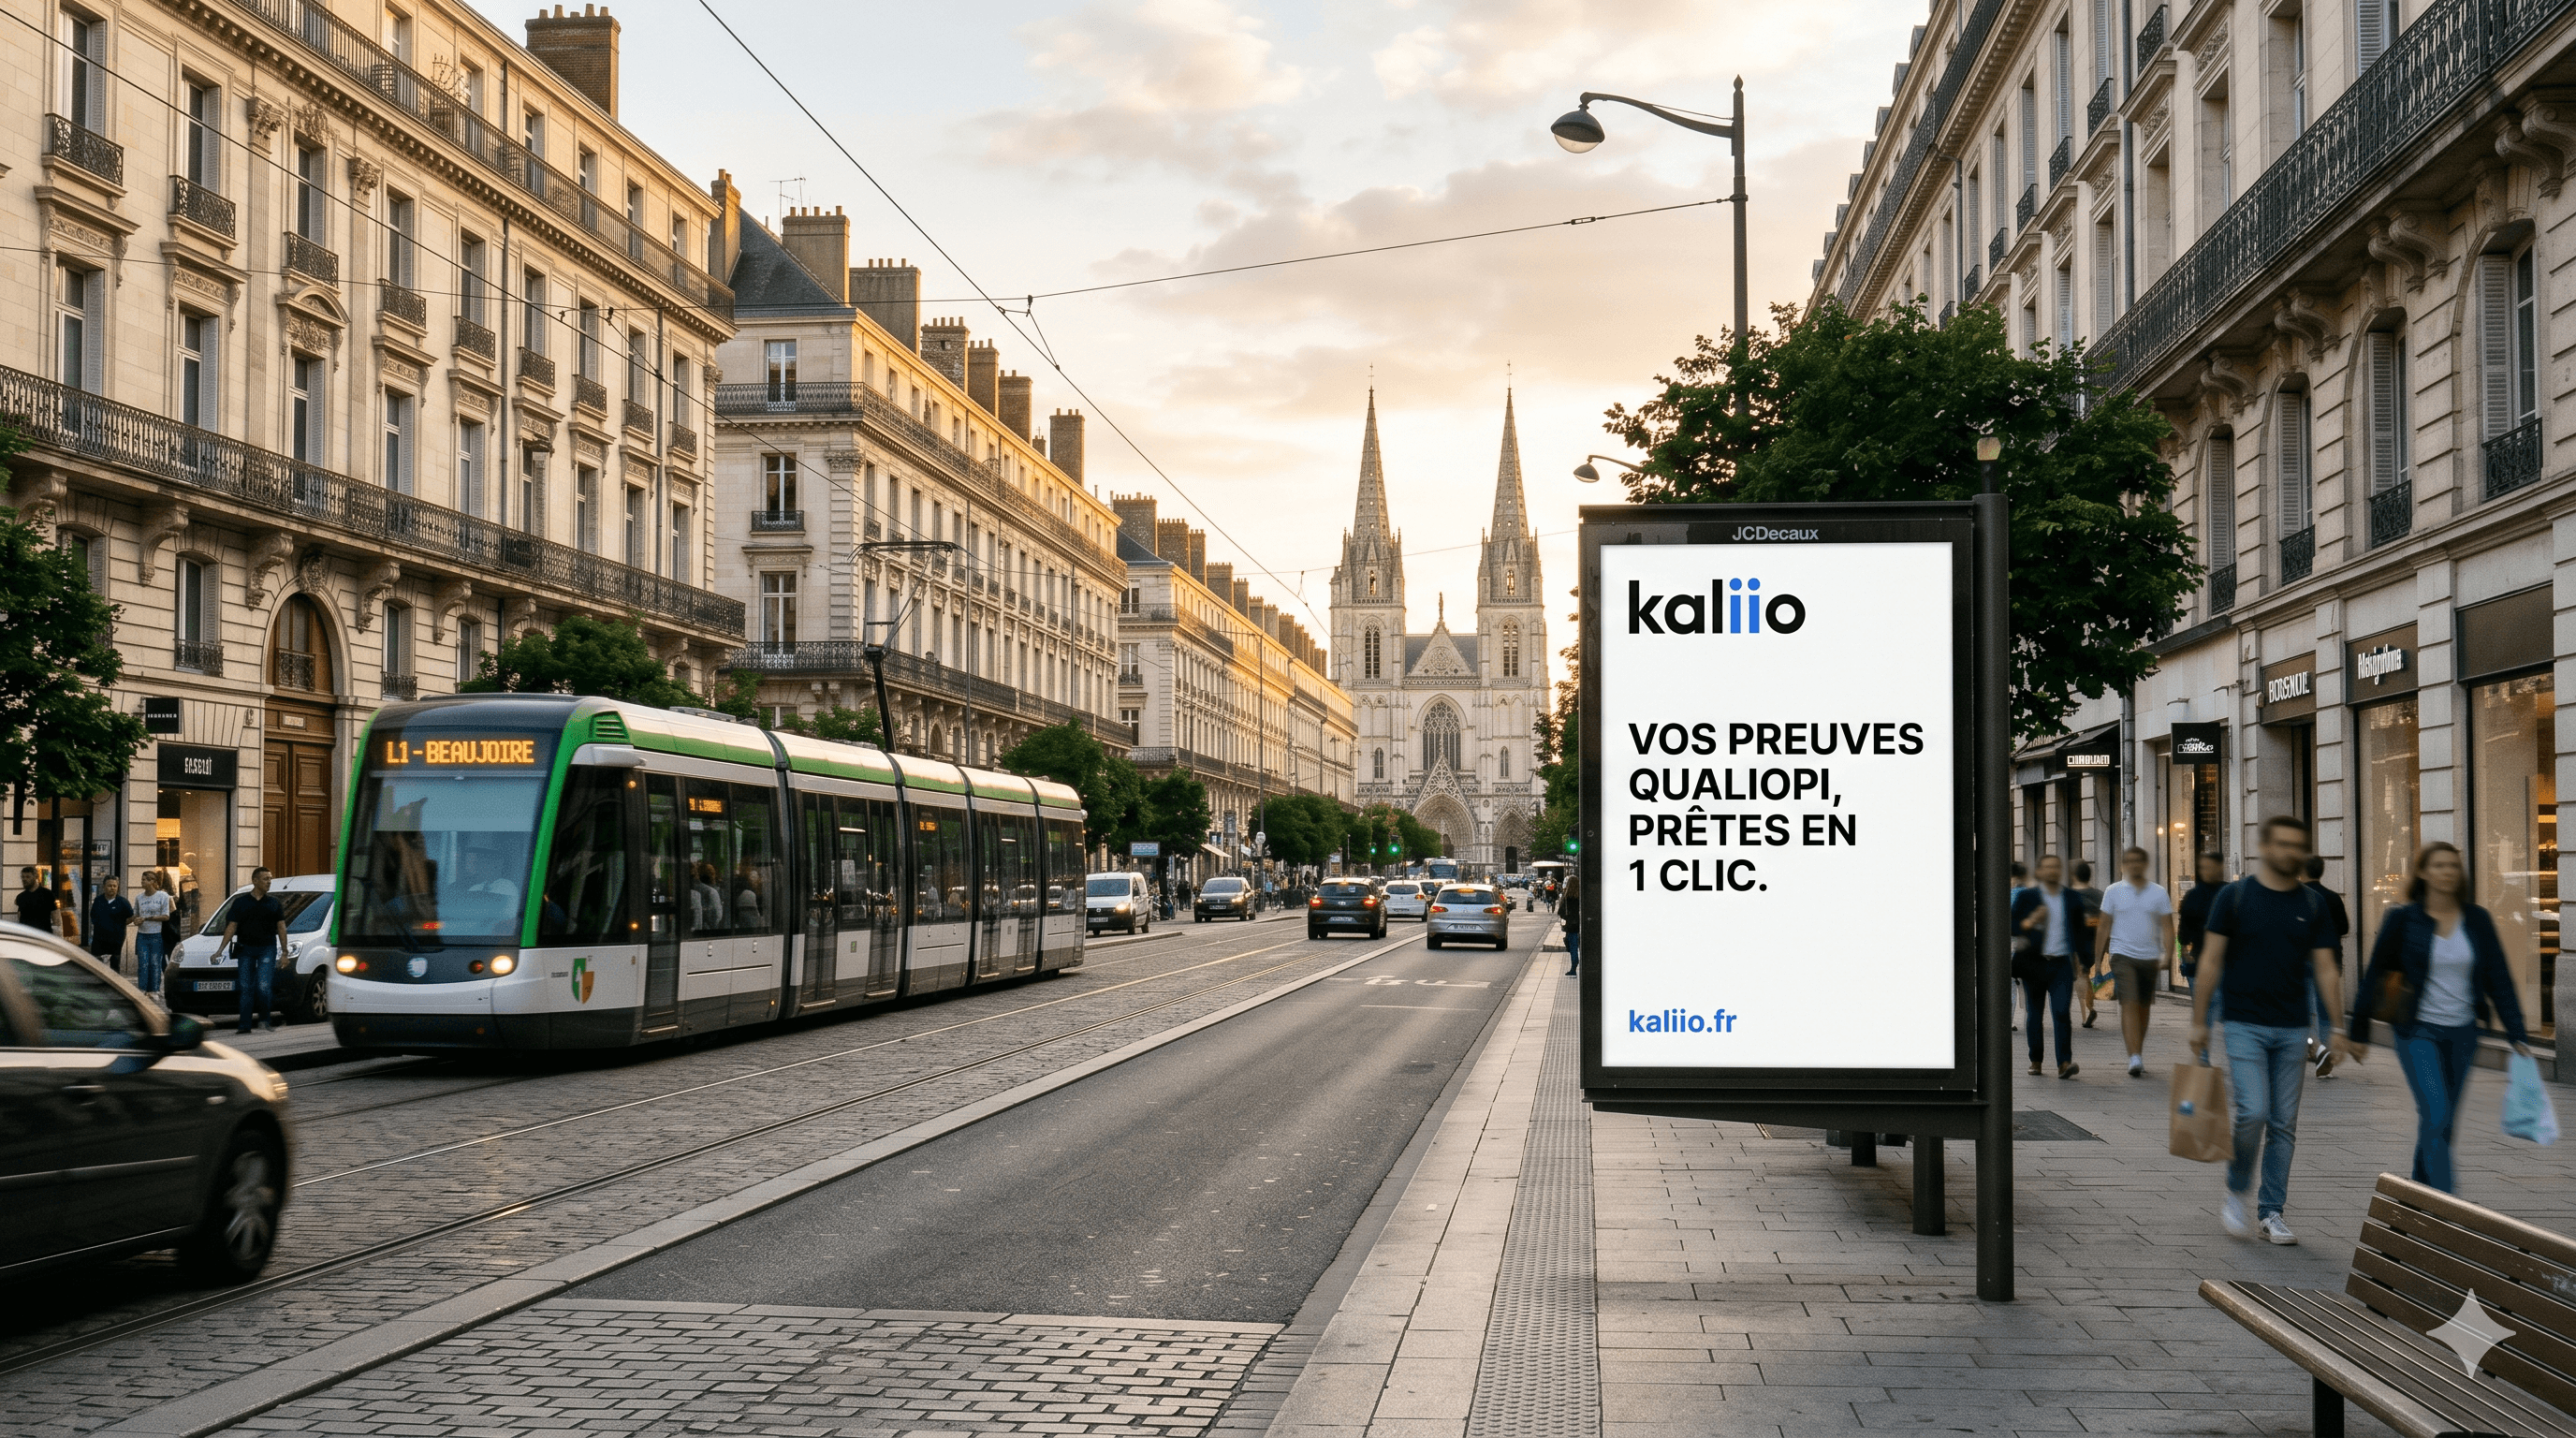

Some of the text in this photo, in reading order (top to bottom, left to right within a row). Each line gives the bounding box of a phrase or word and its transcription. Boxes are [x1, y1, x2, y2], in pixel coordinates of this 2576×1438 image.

[1732, 526, 1819, 541] JCDecaux
[1629, 578, 1807, 635] kaliio
[1629, 723, 1925, 756] VOS PREUVES
[1629, 768, 1841, 807] QUALIOPI,
[1630, 805, 1856, 846] PRÊTES EN
[1629, 858, 1767, 892] 1 CLIC.
[1629, 1008, 1737, 1034] kaliio.fr
